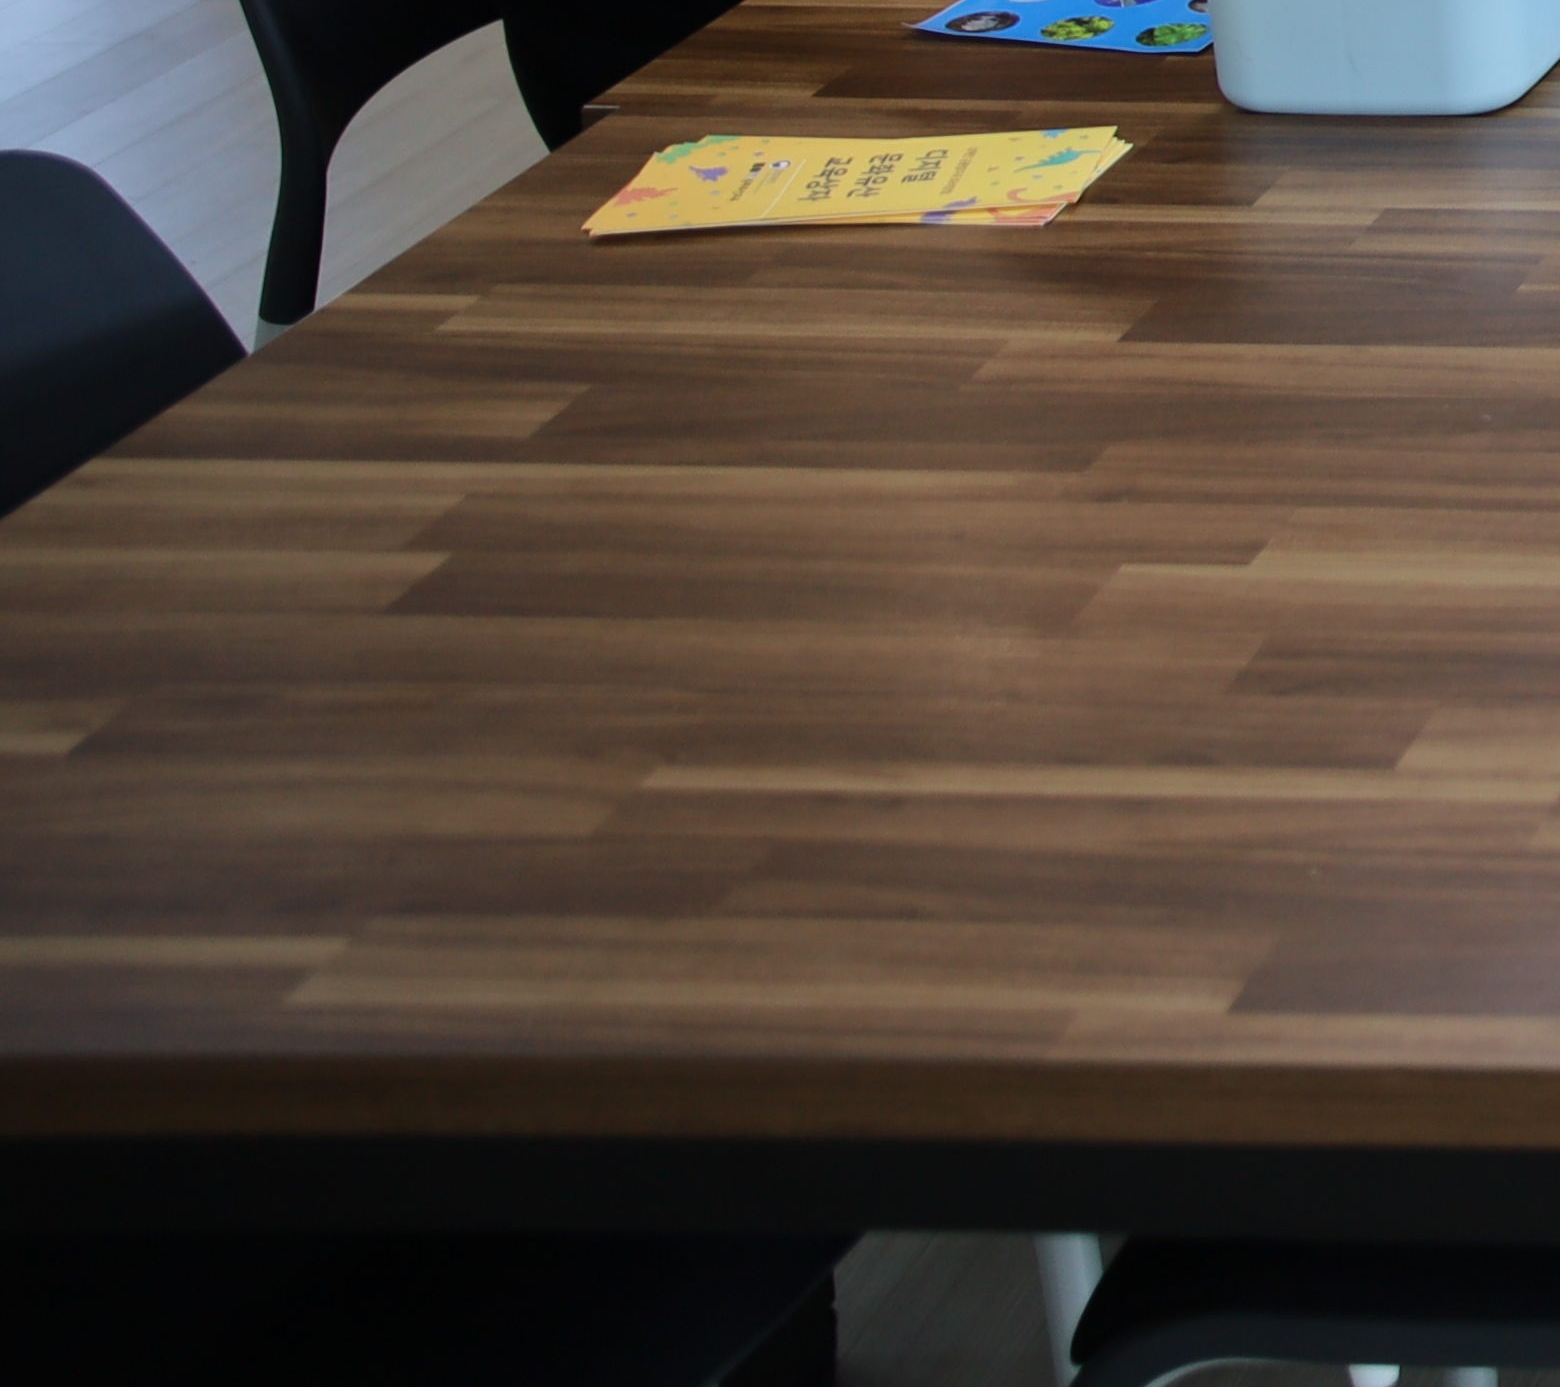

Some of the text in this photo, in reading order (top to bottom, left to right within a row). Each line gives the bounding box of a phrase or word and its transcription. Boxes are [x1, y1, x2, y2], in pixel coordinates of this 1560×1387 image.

[798, 155, 853, 203] 교육상자
[847, 150, 904, 200] 문화유산
[901, 147, 951, 185] 디지털
